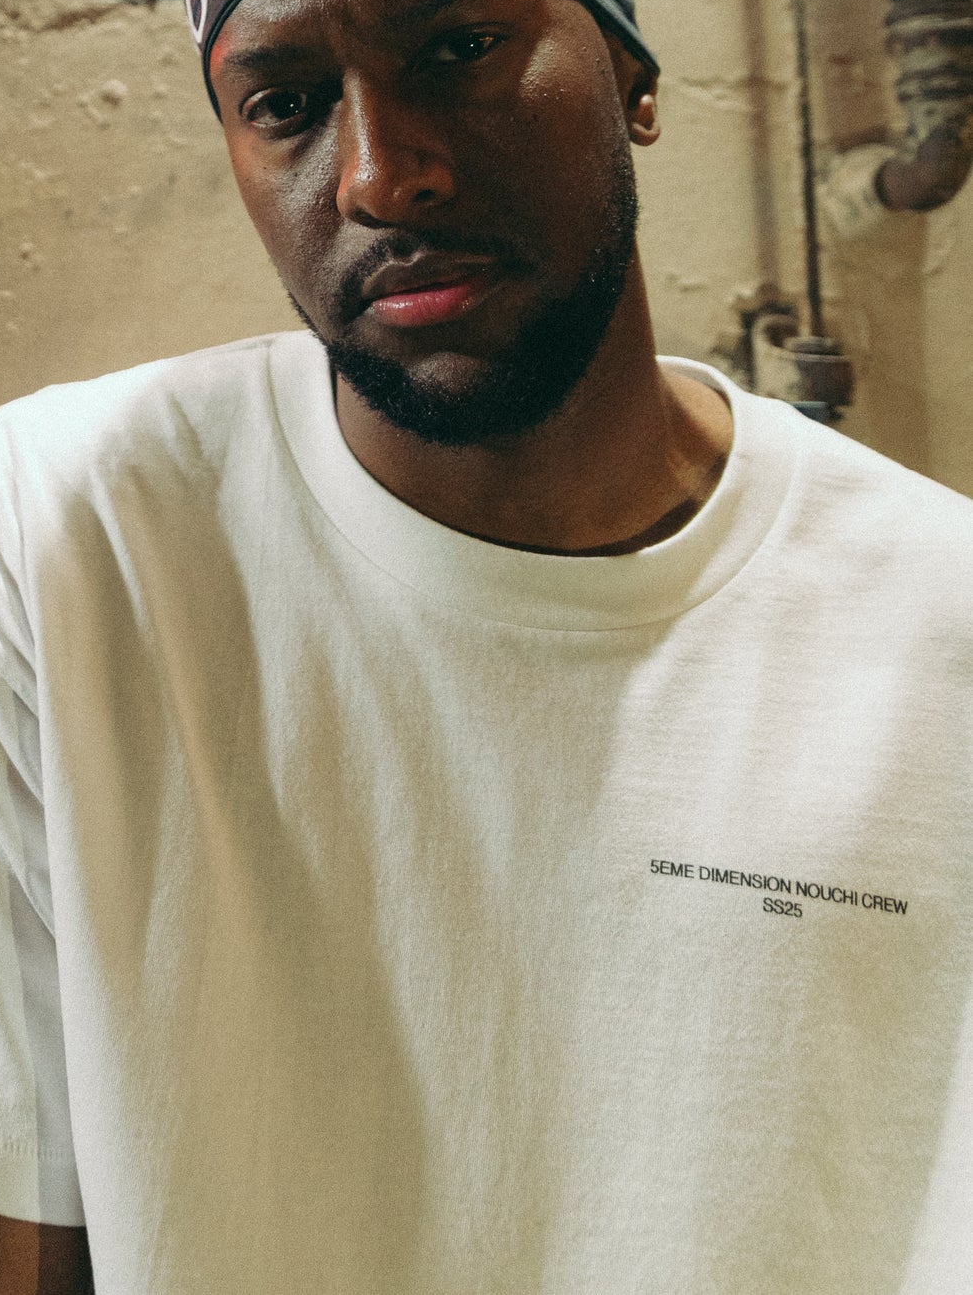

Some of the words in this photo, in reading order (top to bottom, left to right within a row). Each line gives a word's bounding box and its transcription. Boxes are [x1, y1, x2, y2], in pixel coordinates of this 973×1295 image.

[650, 859, 695, 879] 5EME
[698, 865, 792, 894] DIMENSION
[796, 880, 858, 906] NOUCHI
[861, 892, 908, 916] CREW
[762, 896, 803, 918] SS25
